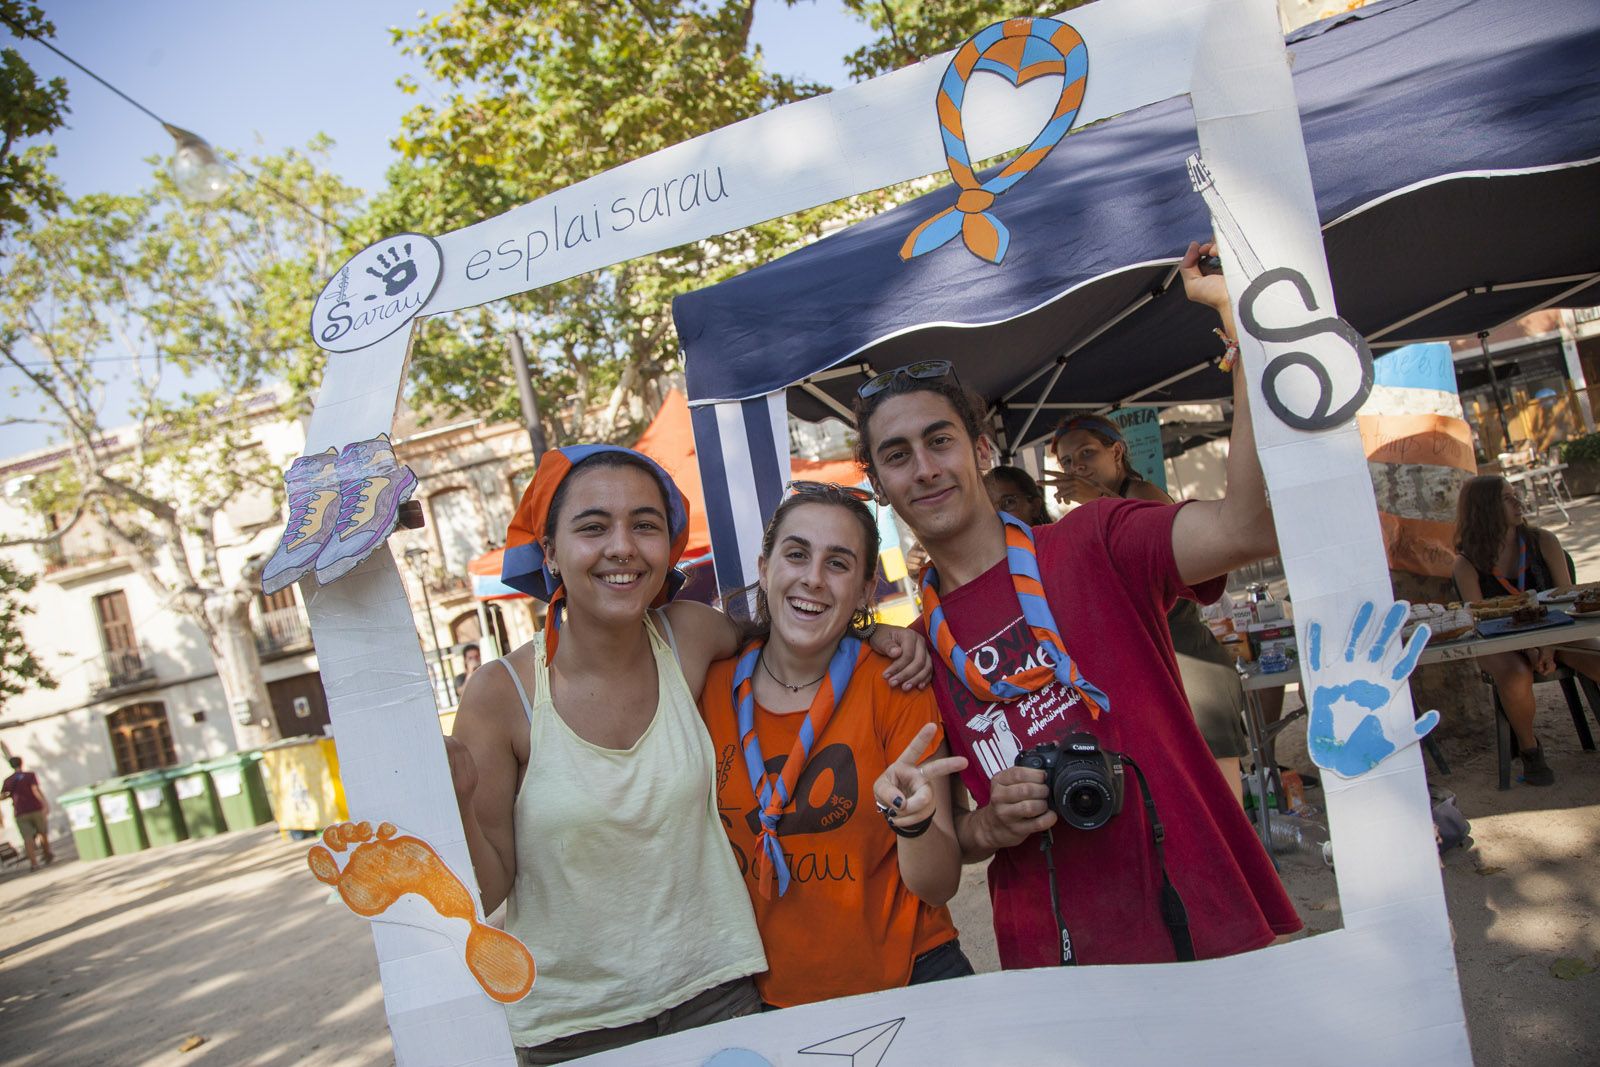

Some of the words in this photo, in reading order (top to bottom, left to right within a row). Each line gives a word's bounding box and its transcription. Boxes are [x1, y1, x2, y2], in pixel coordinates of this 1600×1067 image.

[321, 292, 423, 342] Sarau
[820, 796, 853, 827] anys
[1062, 928, 1072, 962] EOS
